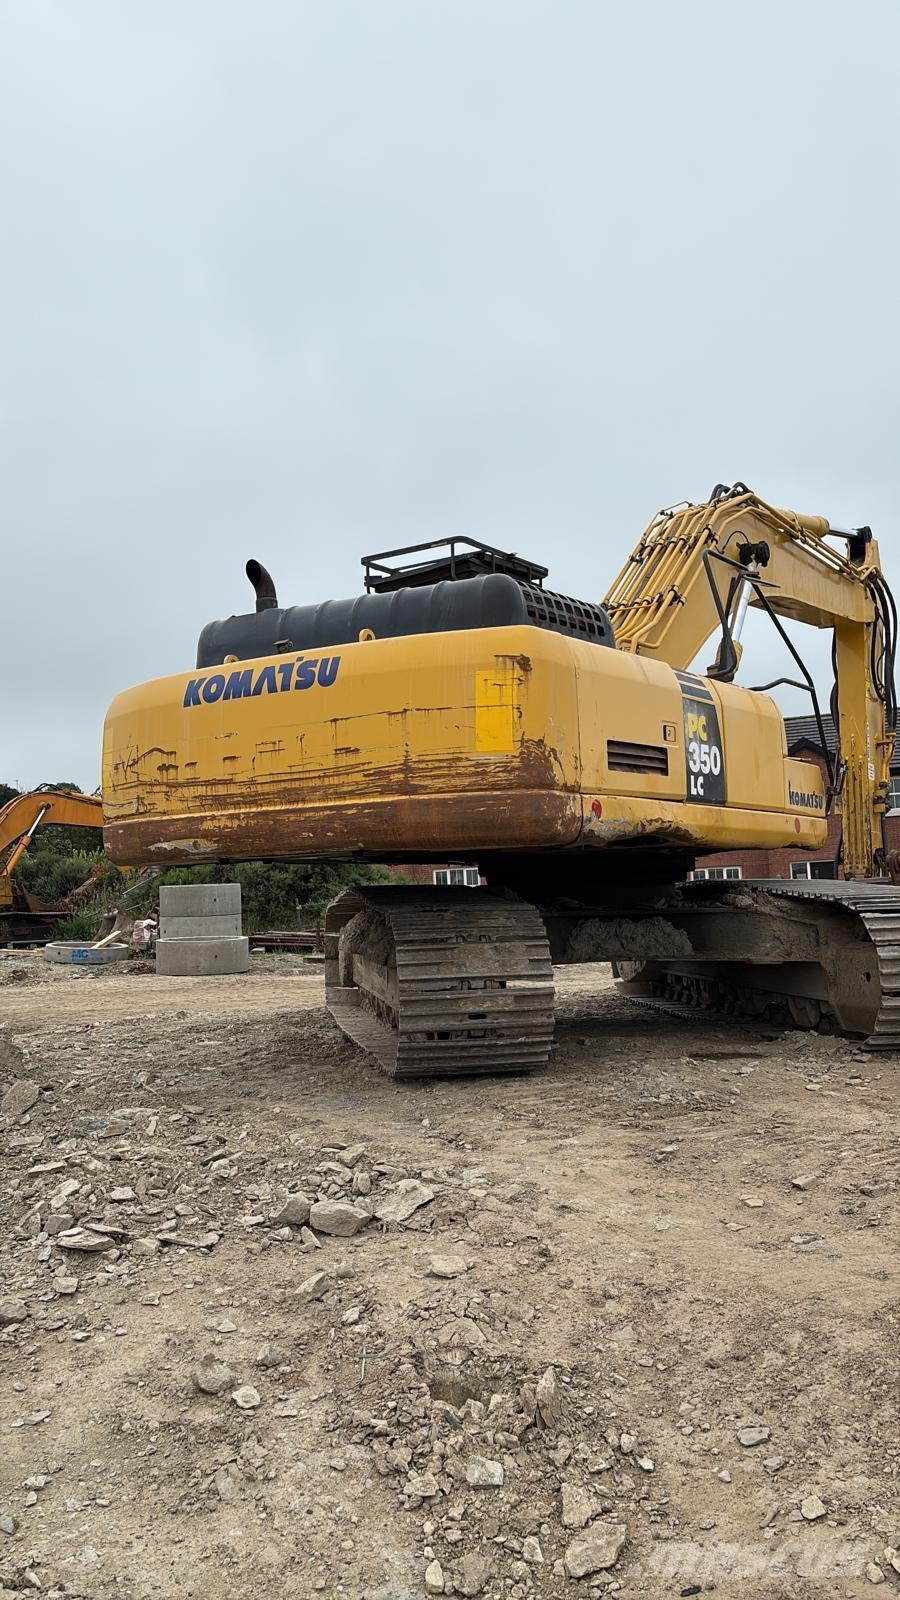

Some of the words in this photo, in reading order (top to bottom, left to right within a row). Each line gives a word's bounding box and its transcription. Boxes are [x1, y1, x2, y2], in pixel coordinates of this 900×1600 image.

[183, 656, 341, 708] KOMATSU
[688, 712, 707, 742] PC
[689, 741, 721, 776] 350
[690, 775, 704, 796] LC
[788, 780, 823, 810] KOMATSU
